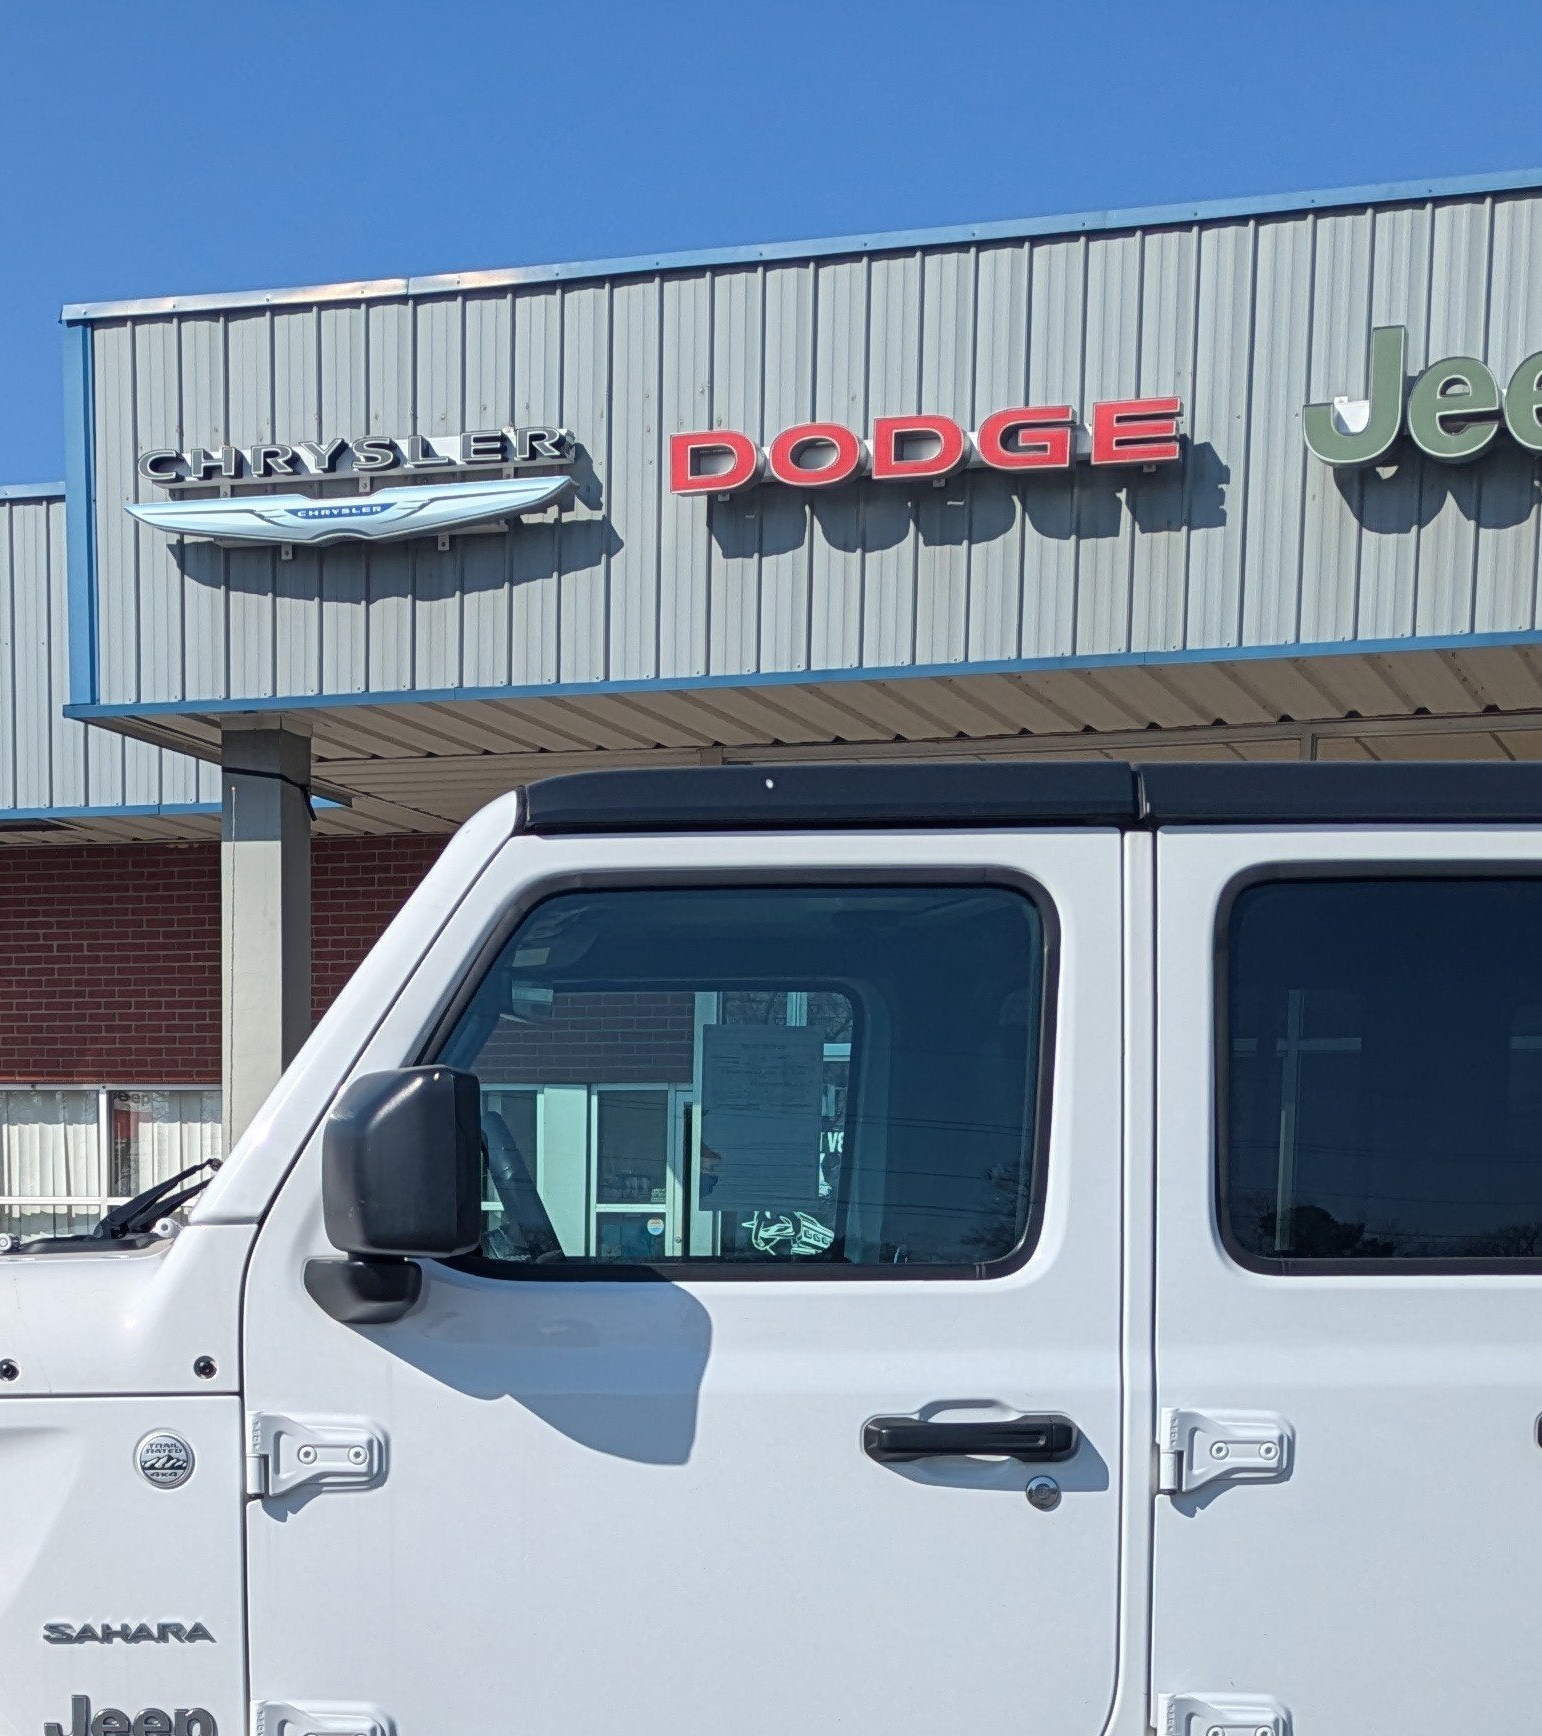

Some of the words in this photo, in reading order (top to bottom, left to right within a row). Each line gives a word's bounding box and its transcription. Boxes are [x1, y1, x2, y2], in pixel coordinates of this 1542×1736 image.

[136, 426, 569, 482] CHRYSLER
[669, 397, 1181, 494] DODGE
[296, 505, 383, 518] CHRYSLER
[42, 1621, 217, 1645] SAHARA
